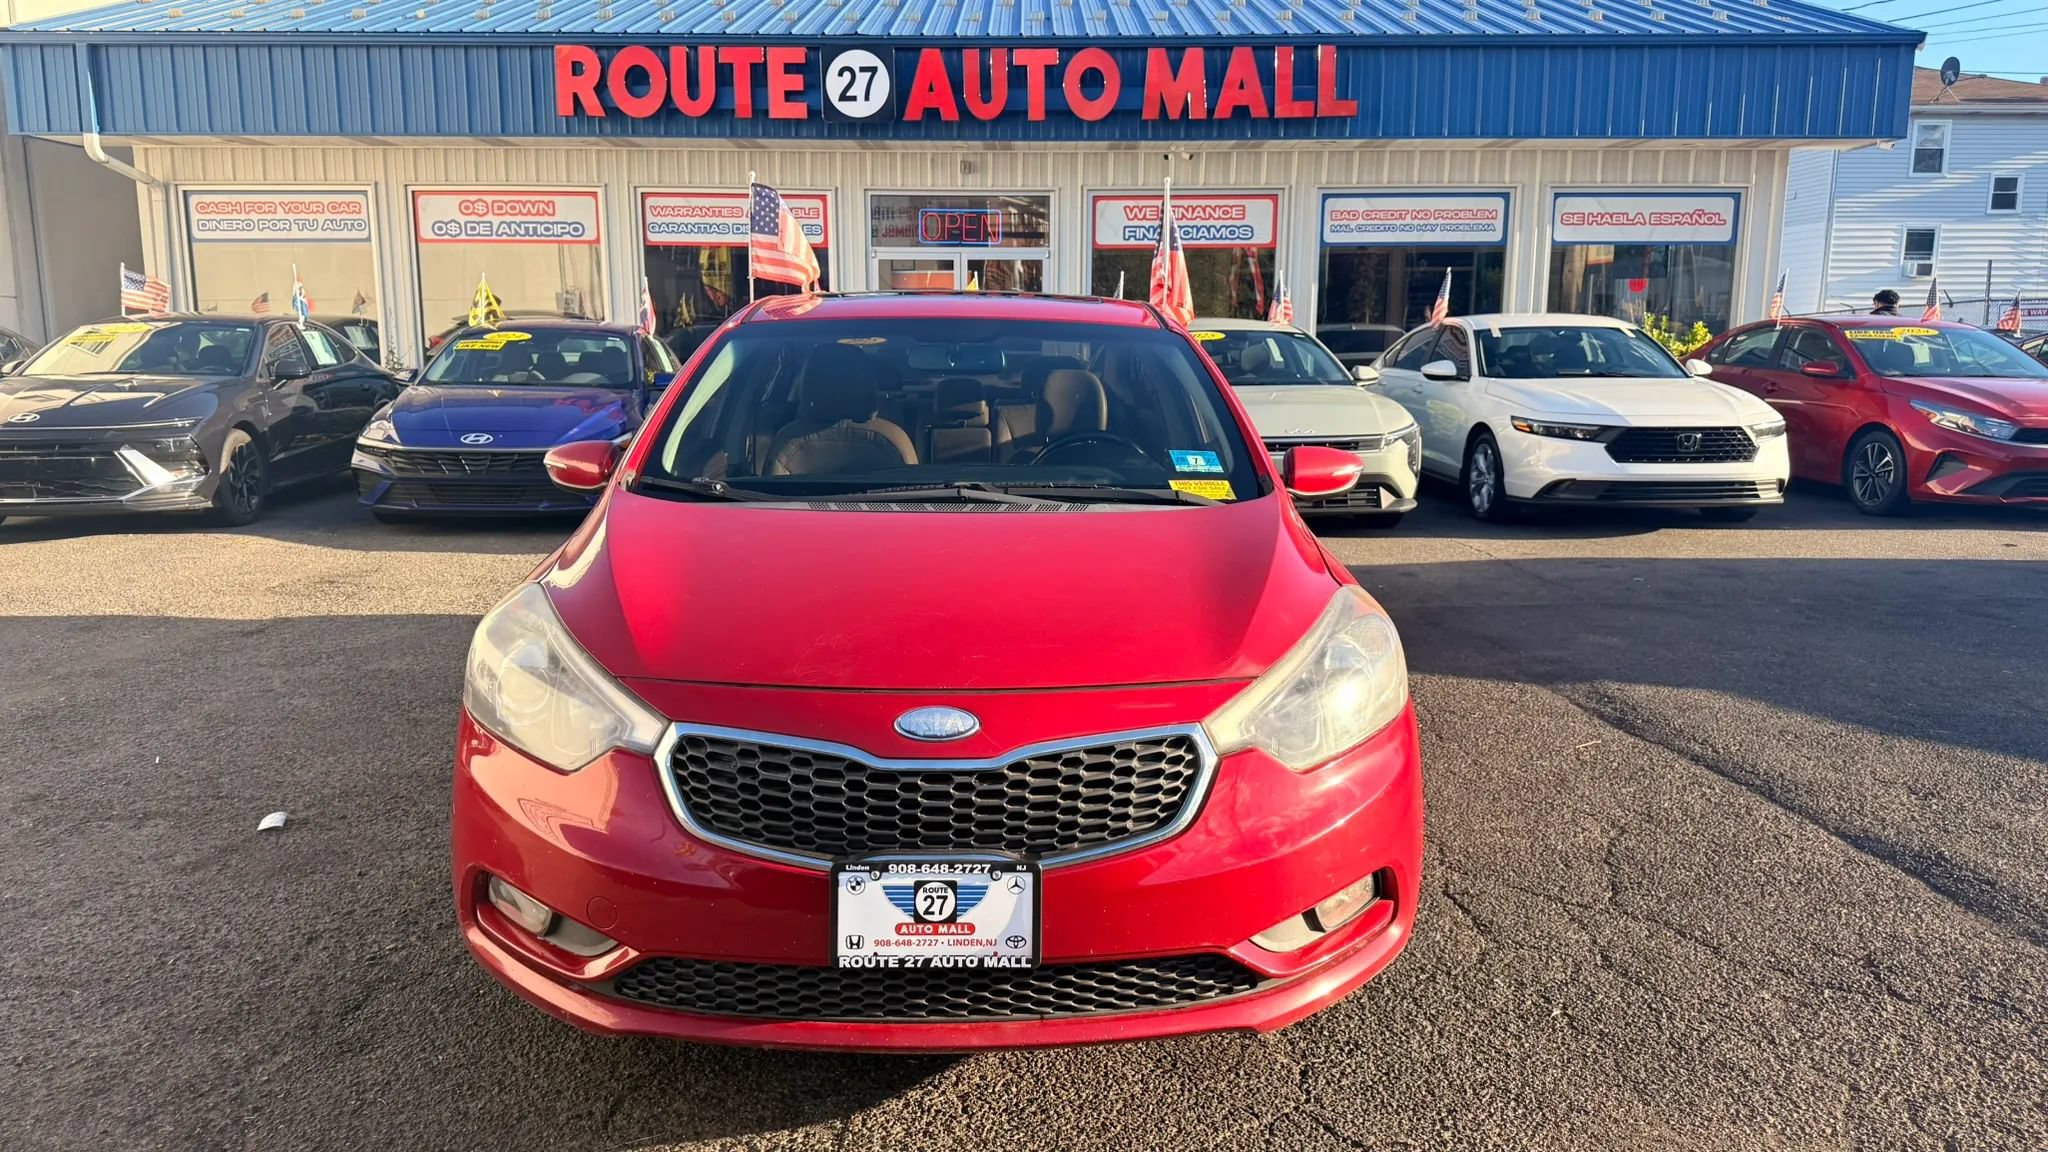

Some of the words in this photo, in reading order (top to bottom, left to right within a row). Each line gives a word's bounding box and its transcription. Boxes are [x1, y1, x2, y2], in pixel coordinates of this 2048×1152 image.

[554, 45, 808, 119] ROUTE
[836, 66, 879, 103] 27
[903, 47, 1121, 121] AUTO
[1142, 45, 1358, 120] MALL
[195, 201, 242, 214] CASH
[244, 201, 276, 214] FOR
[280, 201, 325, 214] YOUR
[327, 201, 362, 214] CAR
[491, 200, 555, 217] DOWN
[650, 205, 743, 218] WARRANTIES
[1123, 205, 1160, 220] WE
[1330, 209, 1360, 221] BAD
[1361, 209, 1409, 221] CREDIT
[1410, 209, 1432, 221] NO
[1433, 209, 1498, 221] PROBLEM
[1560, 212, 1585, 225] SE
[1587, 212, 1646, 225] HABLA
[1649, 209, 1727, 225] ESPAÑOL
[197, 218, 255, 231] DINERO
[257, 218, 291, 231] POR
[294, 218, 318, 231] TU
[321, 218, 367, 231] AUTO
[463, 220, 493, 237] DE
[495, 221, 586, 238] ANTICIPO
[648, 222, 731, 234] GARANTIAS
[922, 212, 1000, 242] OPEN
[1330, 223, 1353, 233] MAL
[1354, 223, 1397, 233] CREDITO
[1399, 223, 1415, 233] NO
[1416, 223, 1438, 233] HAY
[1440, 223, 1496, 233] PROBLEMA
[1123, 225, 1253, 241] FINCIAMOS
[888, 864, 991, 874] 908-648-2727
[922, 895, 949, 916] 27
[900, 924, 933, 934] AUTO
[938, 924, 971, 934] MALL
[873, 939, 939, 947] 908-648-2727
[947, 938, 997, 948] LINDEN,NJ
[838, 956, 900, 968] ROUTE
[904, 956, 924, 968] 27
[930, 956, 979, 968] AUTO
[984, 956, 1032, 968] MALL
